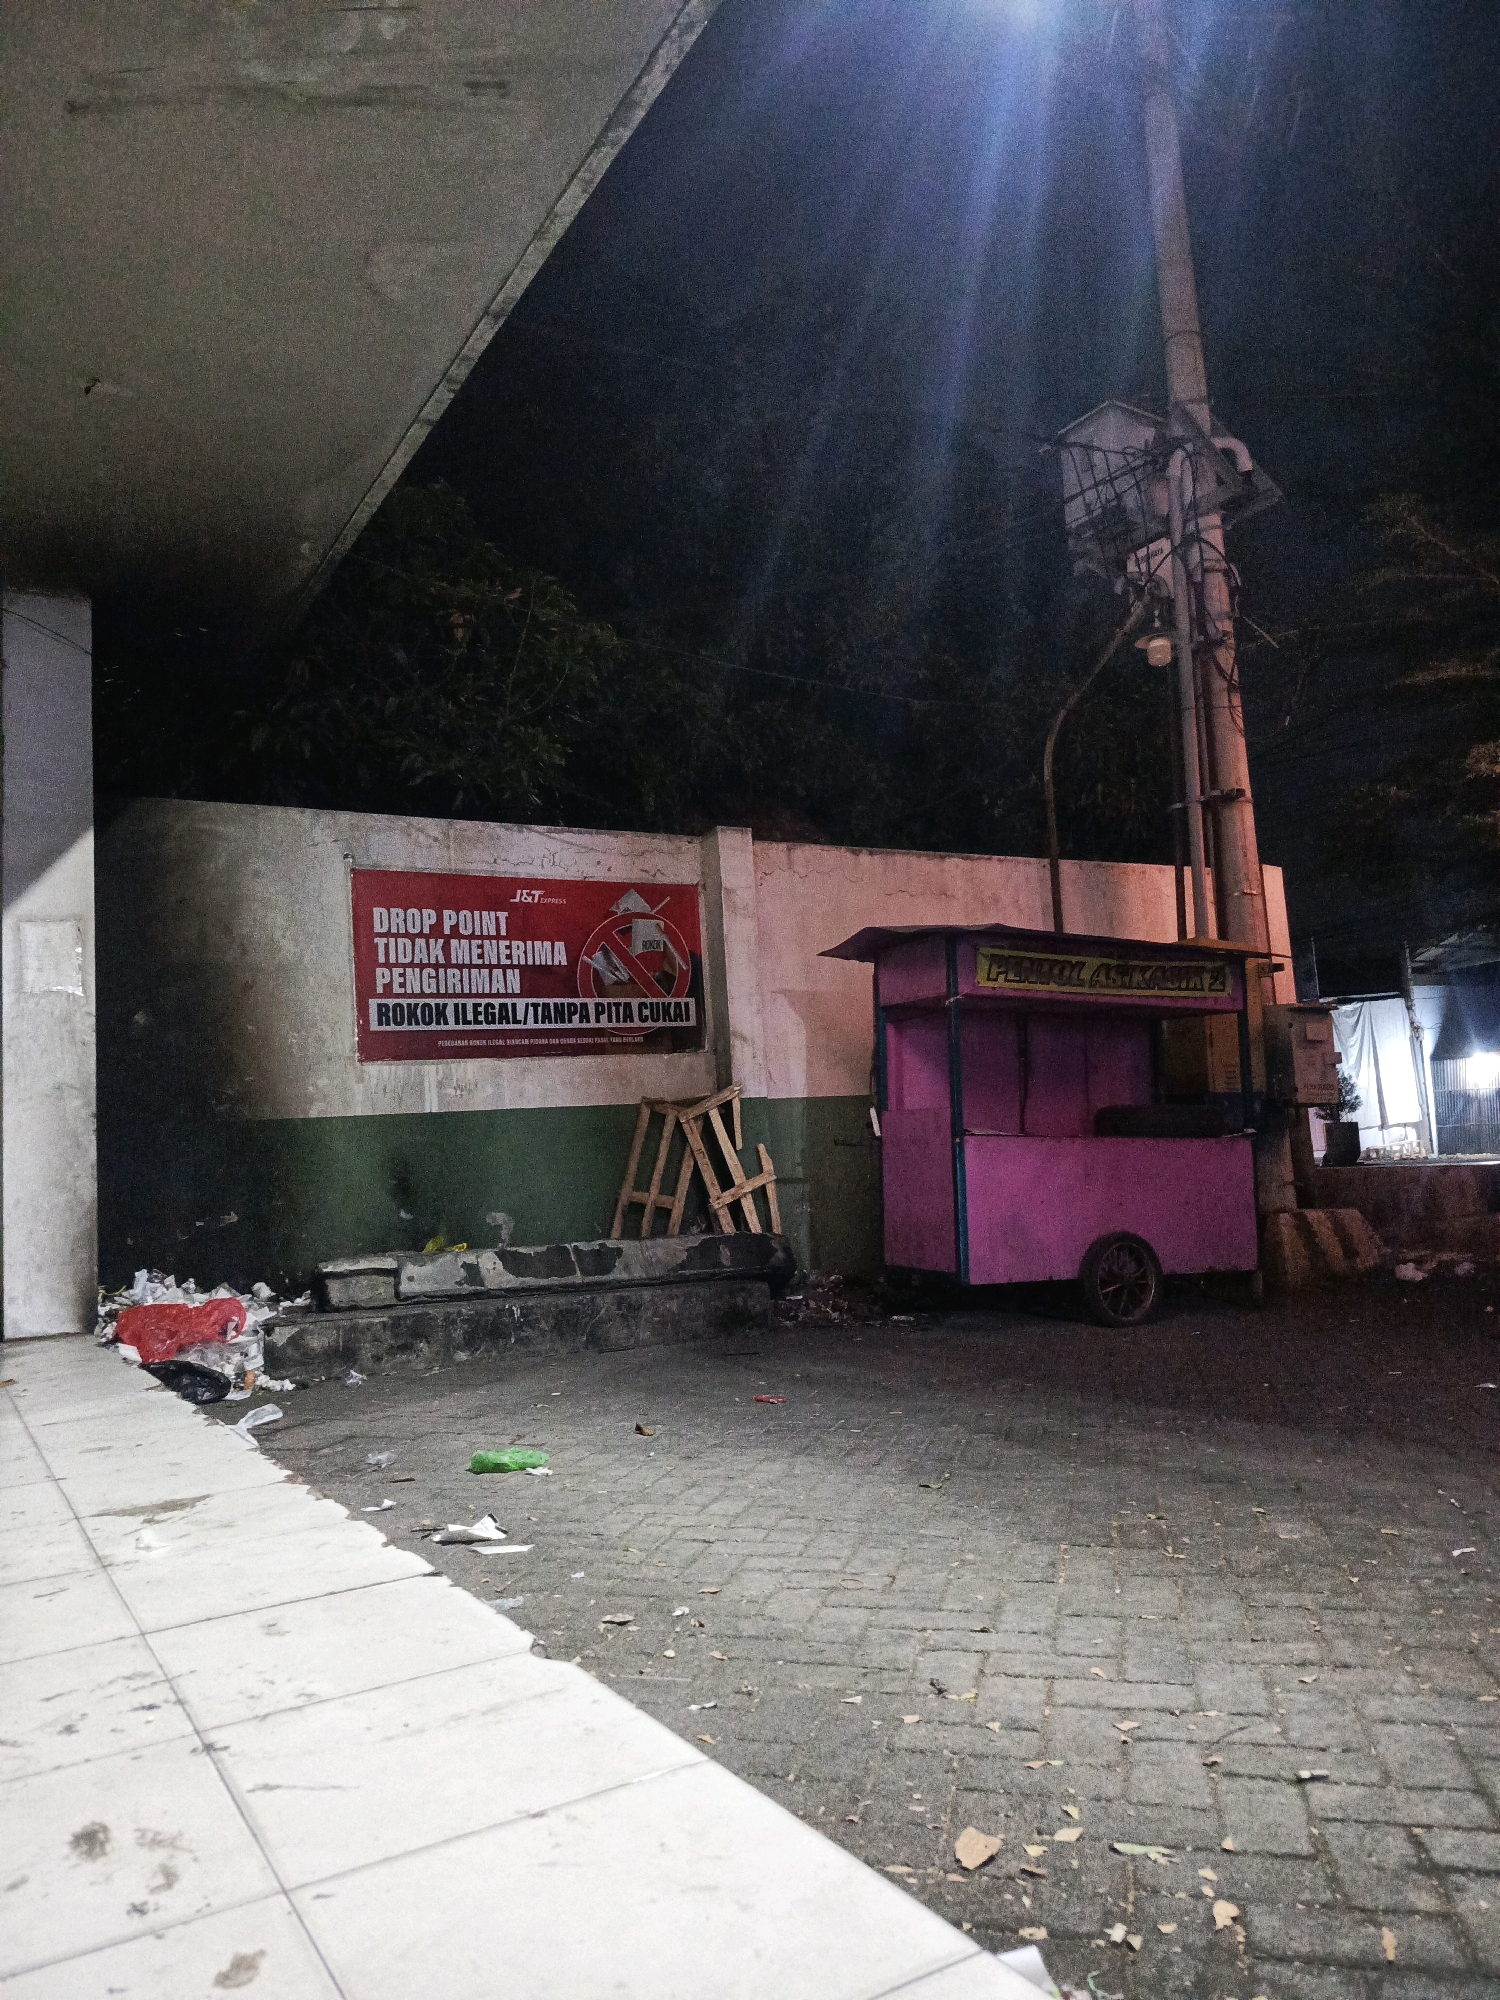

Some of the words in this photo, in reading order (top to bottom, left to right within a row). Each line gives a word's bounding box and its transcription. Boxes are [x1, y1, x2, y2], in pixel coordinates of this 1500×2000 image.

[510, 889, 544, 904] J&T
[373, 907, 440, 934] DROP
[443, 909, 508, 936] POINT
[374, 937, 447, 964] TIDAK
[451, 940, 567, 966] MENERIMA
[376, 968, 521, 994] PENGIRIMAN
[377, 1002, 449, 1027] ROKOK
[454, 1001, 591, 1026] ILEGAL/TANPA
[595, 1001, 635, 1025] PITA
[638, 1001, 691, 1024] CUKAI
